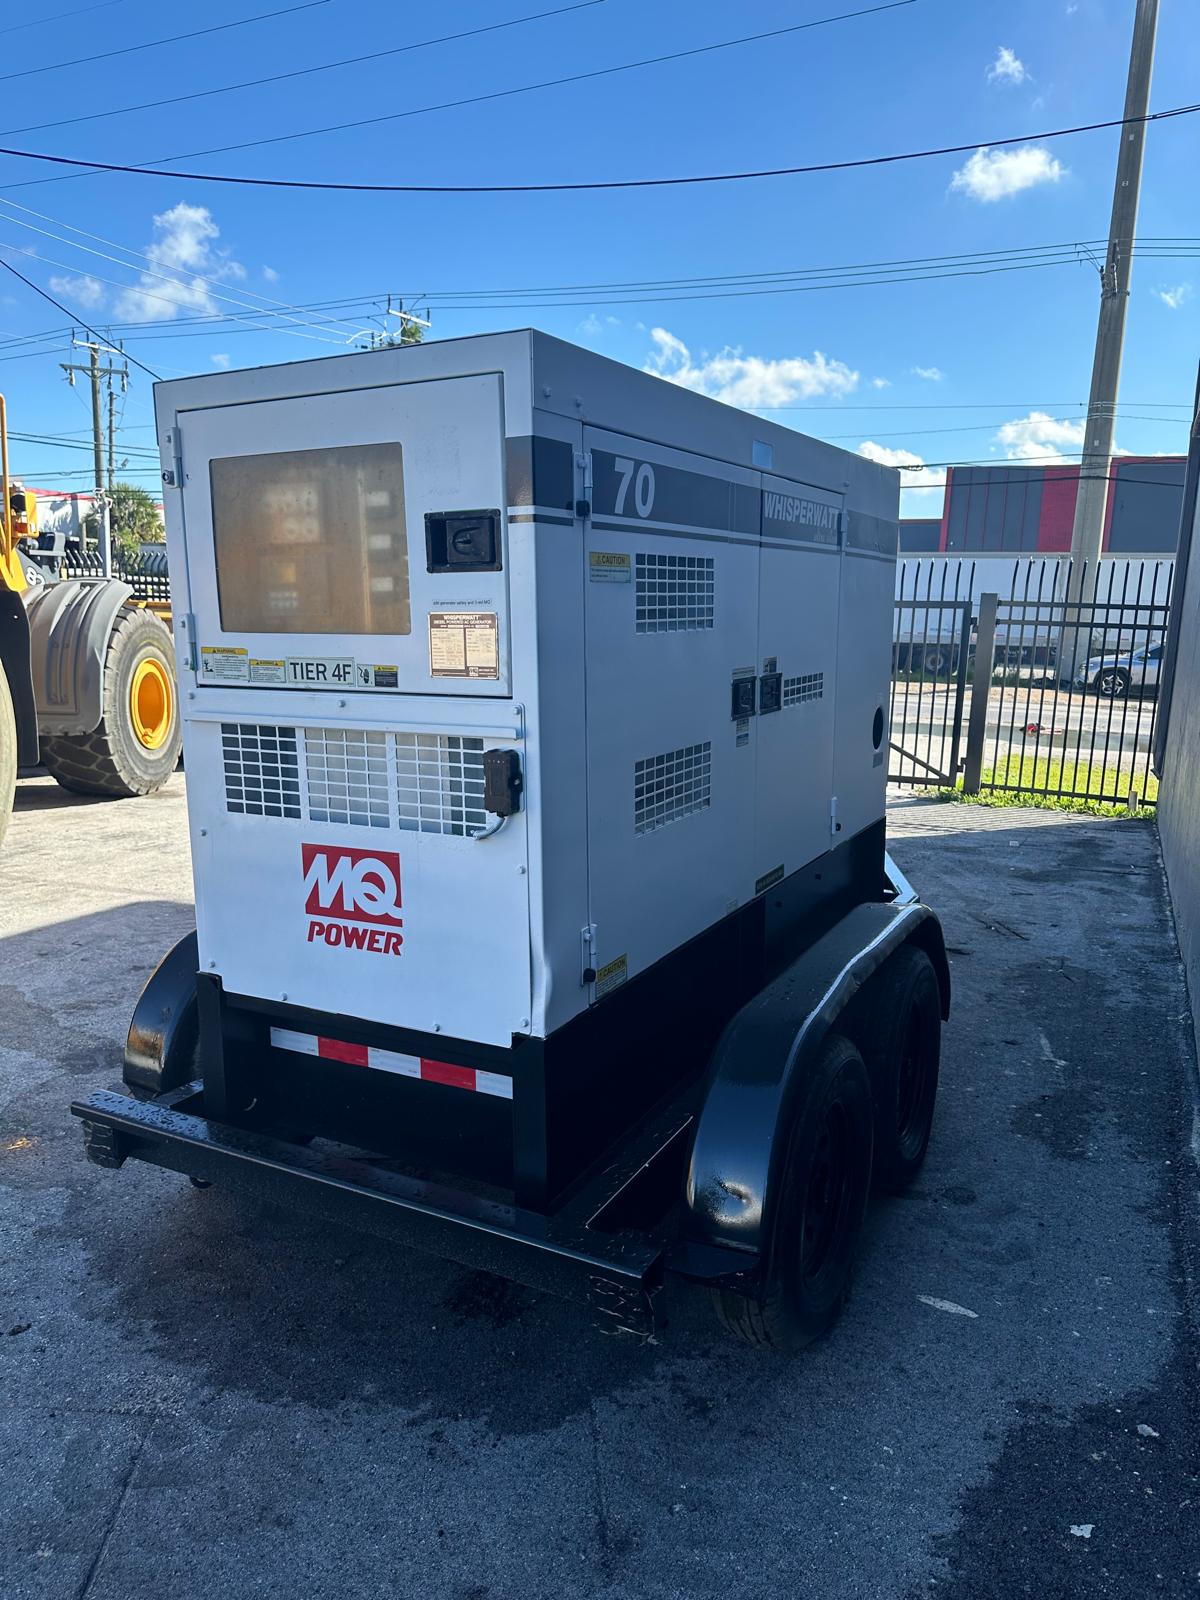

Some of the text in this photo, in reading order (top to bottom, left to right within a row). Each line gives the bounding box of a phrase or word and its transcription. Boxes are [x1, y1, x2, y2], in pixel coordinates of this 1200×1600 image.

[614, 457, 656, 518] 70
[764, 491, 840, 530] WHISPERWATT
[601, 555, 625, 565] CAUTION
[290, 661, 327, 682] TIER
[331, 663, 352, 682] 4F
[303, 853, 403, 920] MQ
[307, 921, 404, 956] POWER
[604, 958, 625, 977] CAUTION
